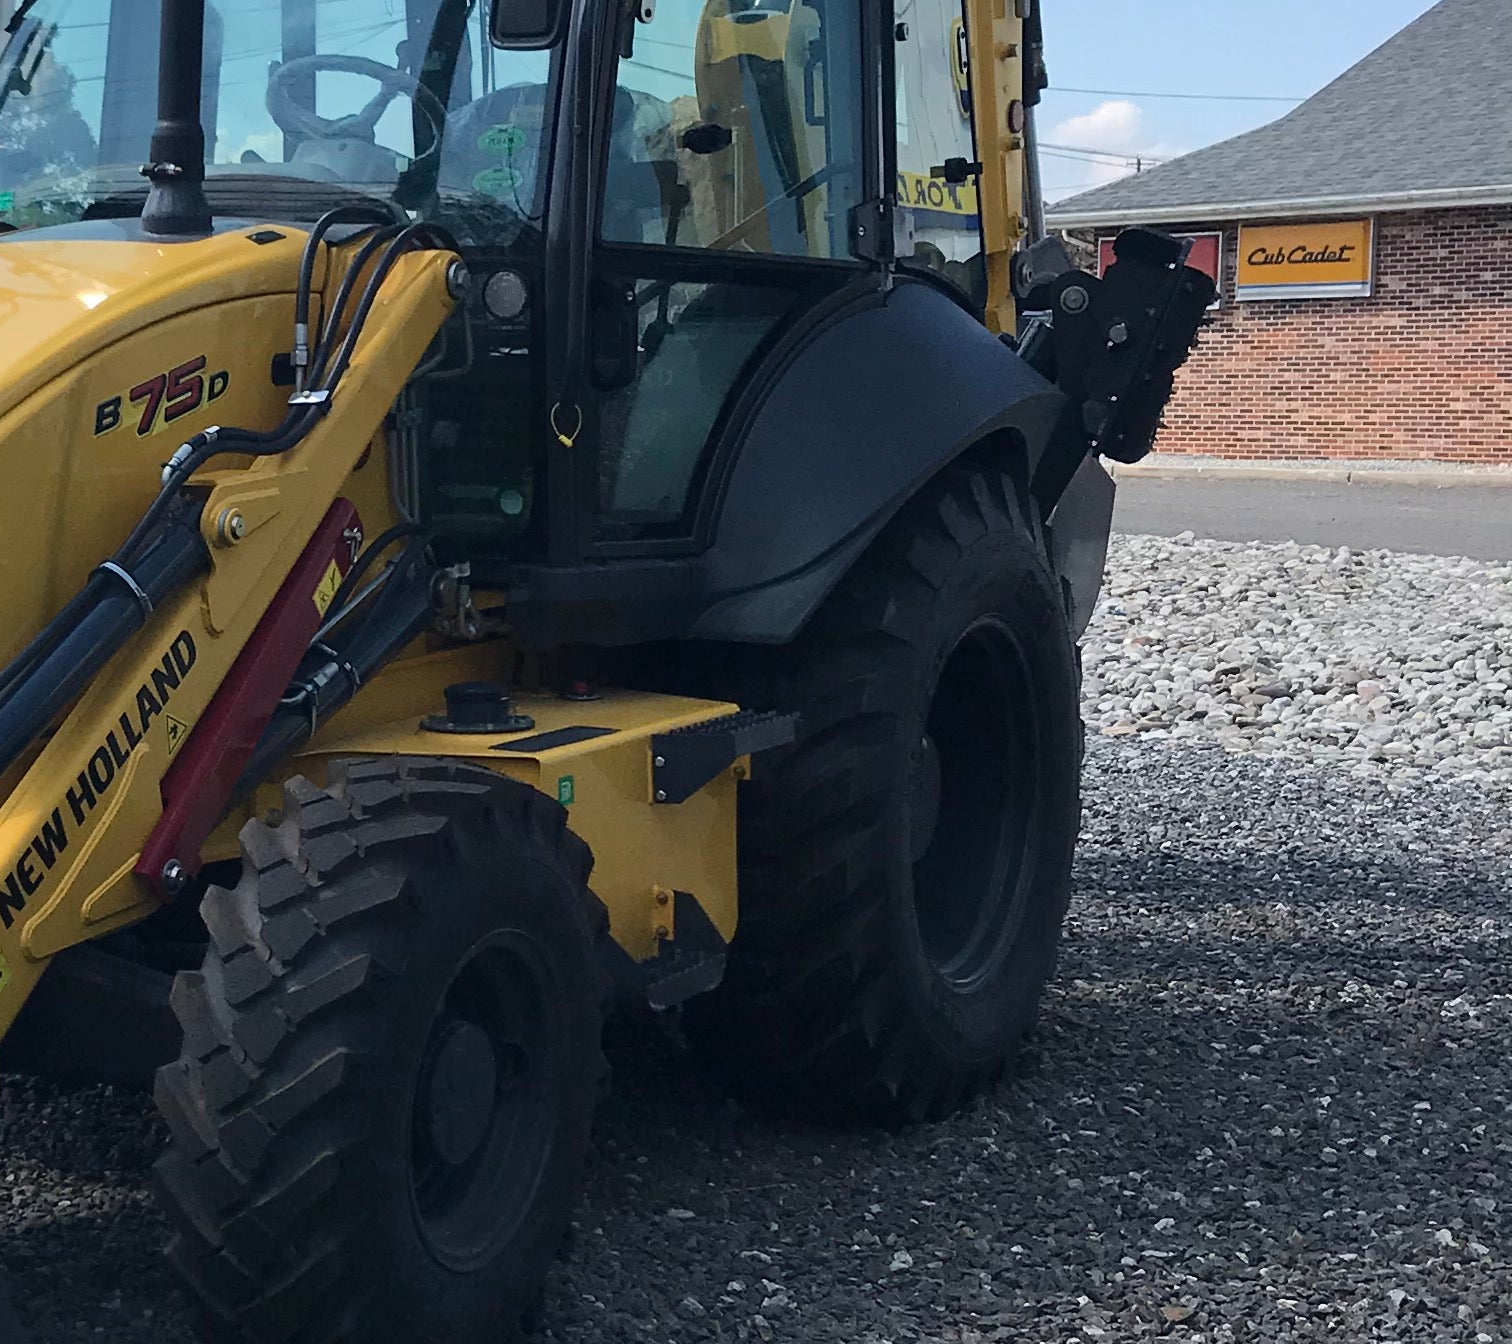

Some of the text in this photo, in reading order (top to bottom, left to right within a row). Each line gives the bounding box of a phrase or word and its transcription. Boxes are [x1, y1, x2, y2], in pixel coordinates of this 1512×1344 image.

[1247, 244, 1356, 265] Cub Cadet
[65, 629, 197, 828] HOLLAND
